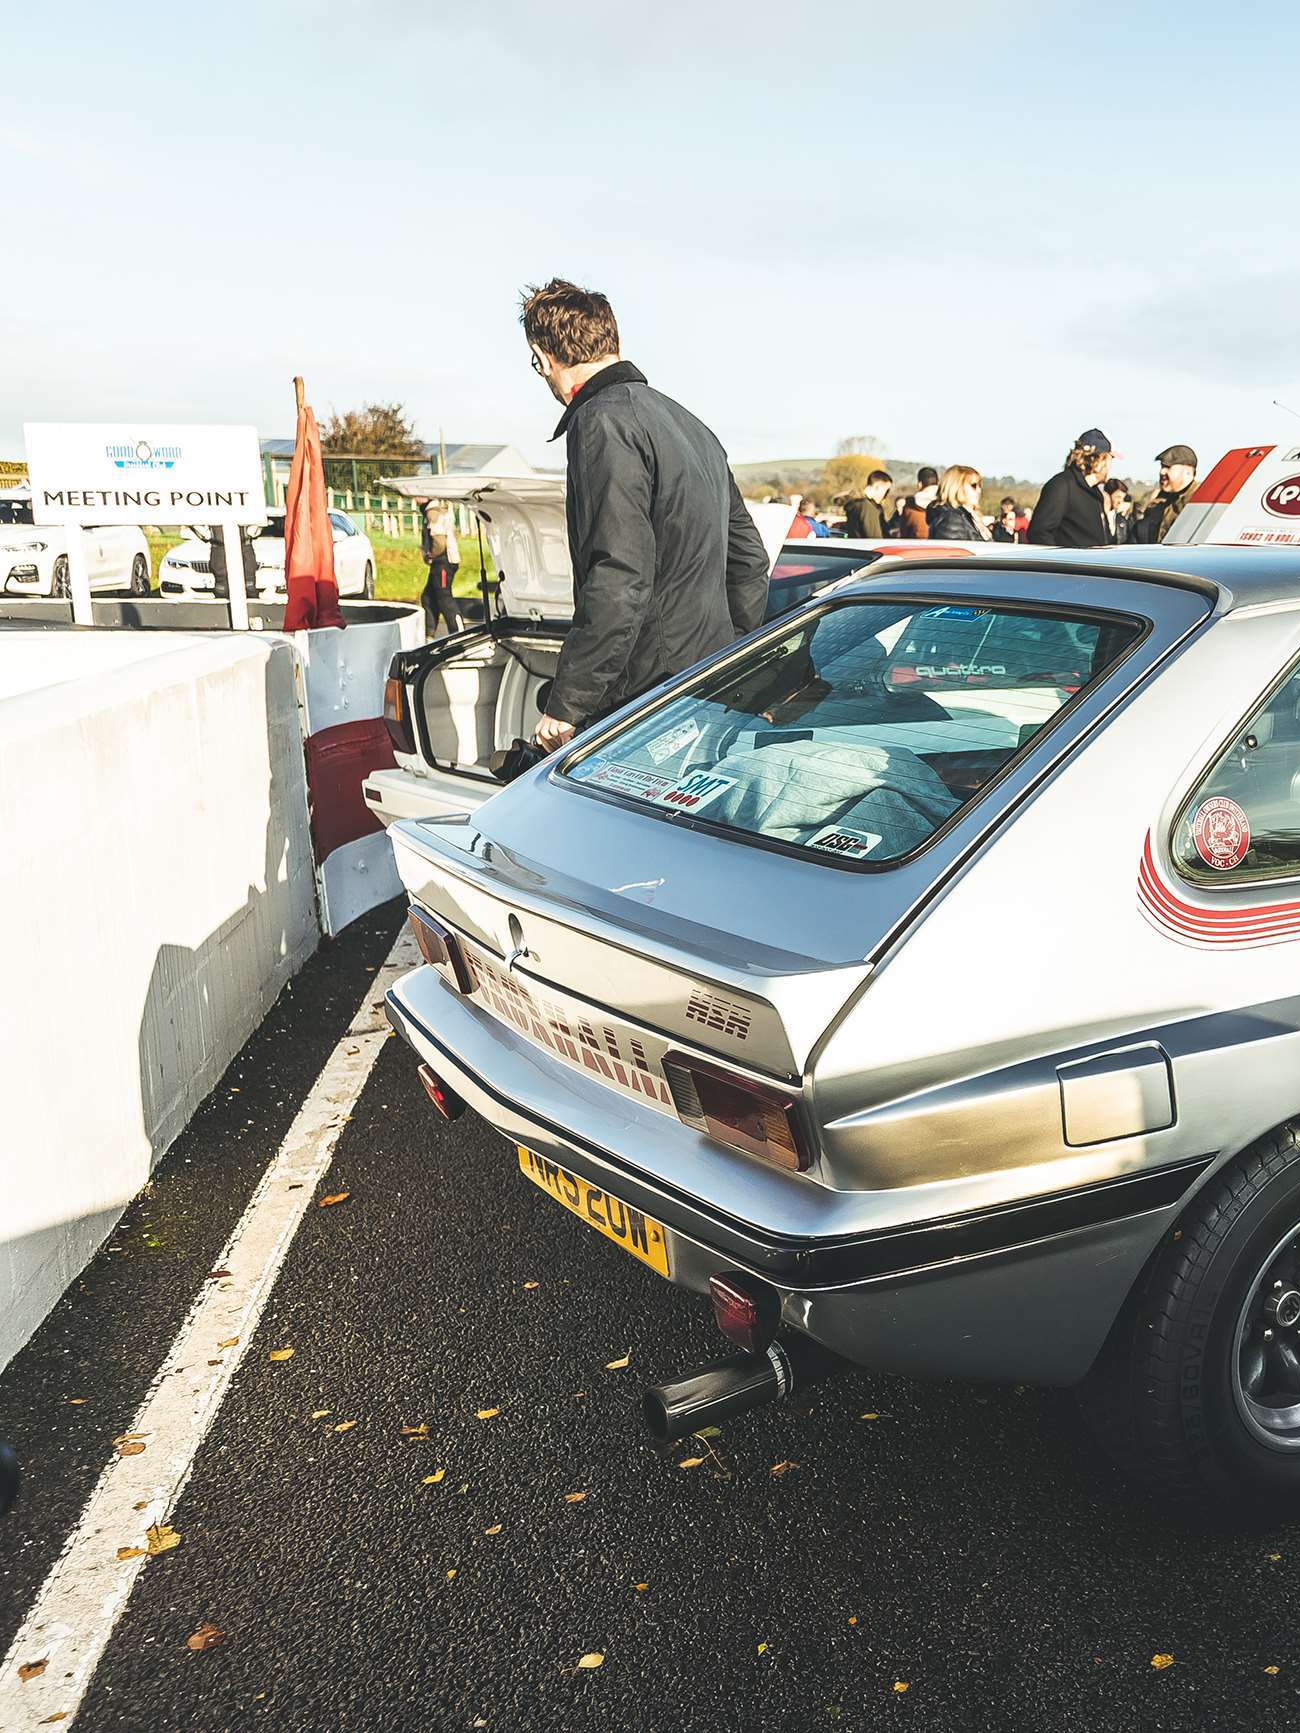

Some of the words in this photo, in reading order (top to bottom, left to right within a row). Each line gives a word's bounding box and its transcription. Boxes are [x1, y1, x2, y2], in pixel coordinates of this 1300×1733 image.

[44, 491, 160, 506] MEETING
[171, 491, 249, 507] POINT
[915, 663, 1006, 679] quattro
[677, 774, 730, 798] SMT
[1210, 856, 1225, 867] VOC
[1229, 856, 1240, 865] CH
[686, 989, 752, 1040] HSR
